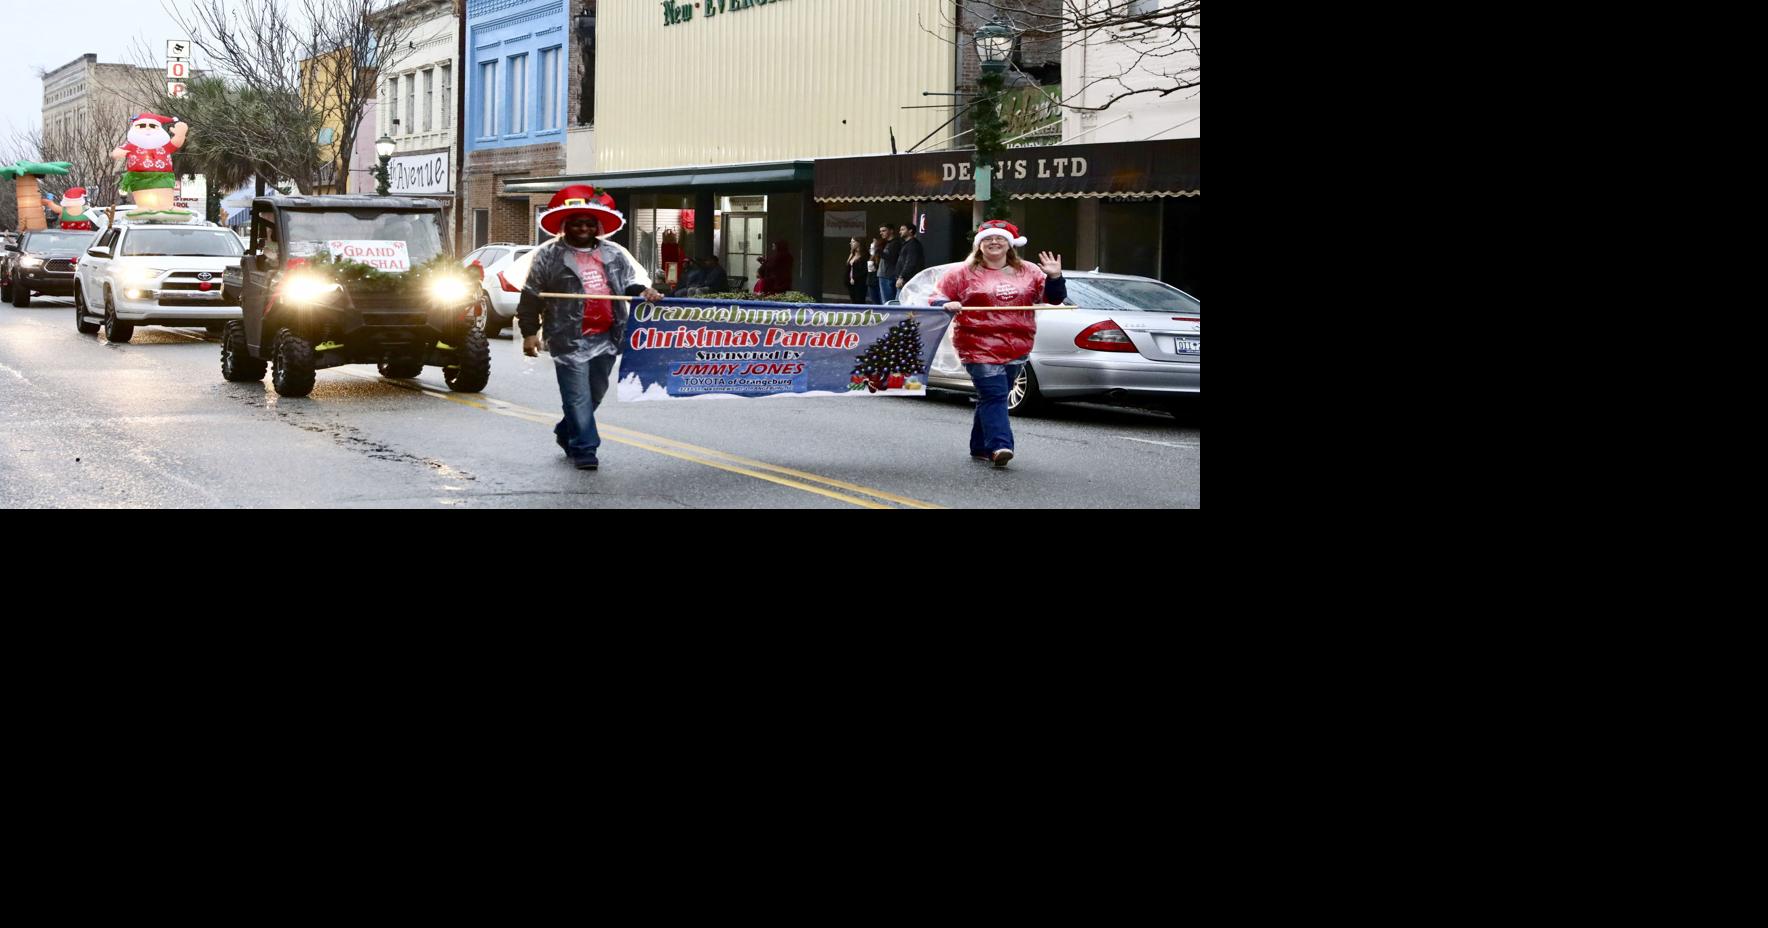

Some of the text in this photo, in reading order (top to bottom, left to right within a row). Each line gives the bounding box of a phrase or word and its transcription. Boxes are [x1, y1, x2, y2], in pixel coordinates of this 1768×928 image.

[396, 156, 445, 190] Avenue
[942, 157, 1088, 182] DEN'S LTD
[343, 245, 396, 257] GRAND
[634, 302, 890, 327] Orangeburg County
[630, 325, 860, 350] Christmas Parade
[695, 351, 780, 360] Sponsored
[672, 362, 805, 376] JIMMY JONES
[684, 378, 726, 386] TOYOTA
[738, 378, 793, 387] Orangeburg
